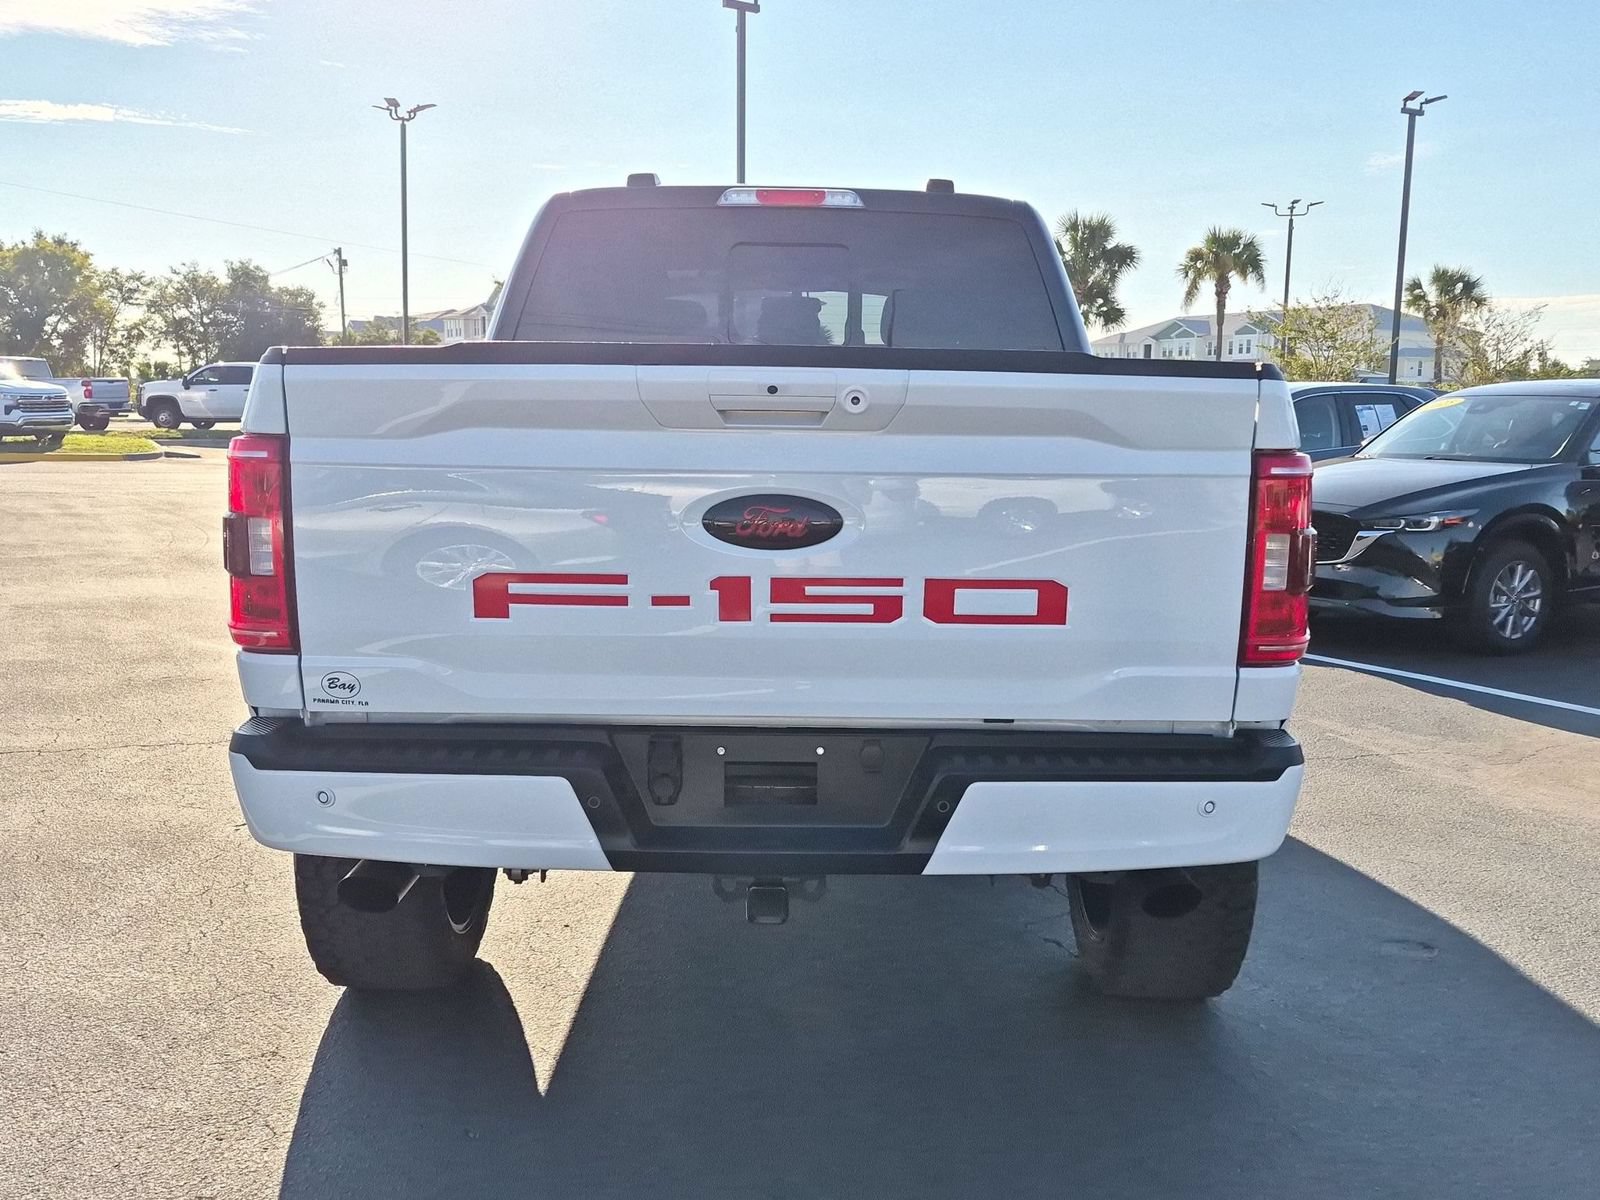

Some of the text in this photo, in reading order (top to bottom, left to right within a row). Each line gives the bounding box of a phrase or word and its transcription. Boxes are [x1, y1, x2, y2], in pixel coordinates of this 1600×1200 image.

[736, 505, 810, 537] Ford
[473, 572, 1068, 625] F-150
[327, 677, 356, 693] Bay
